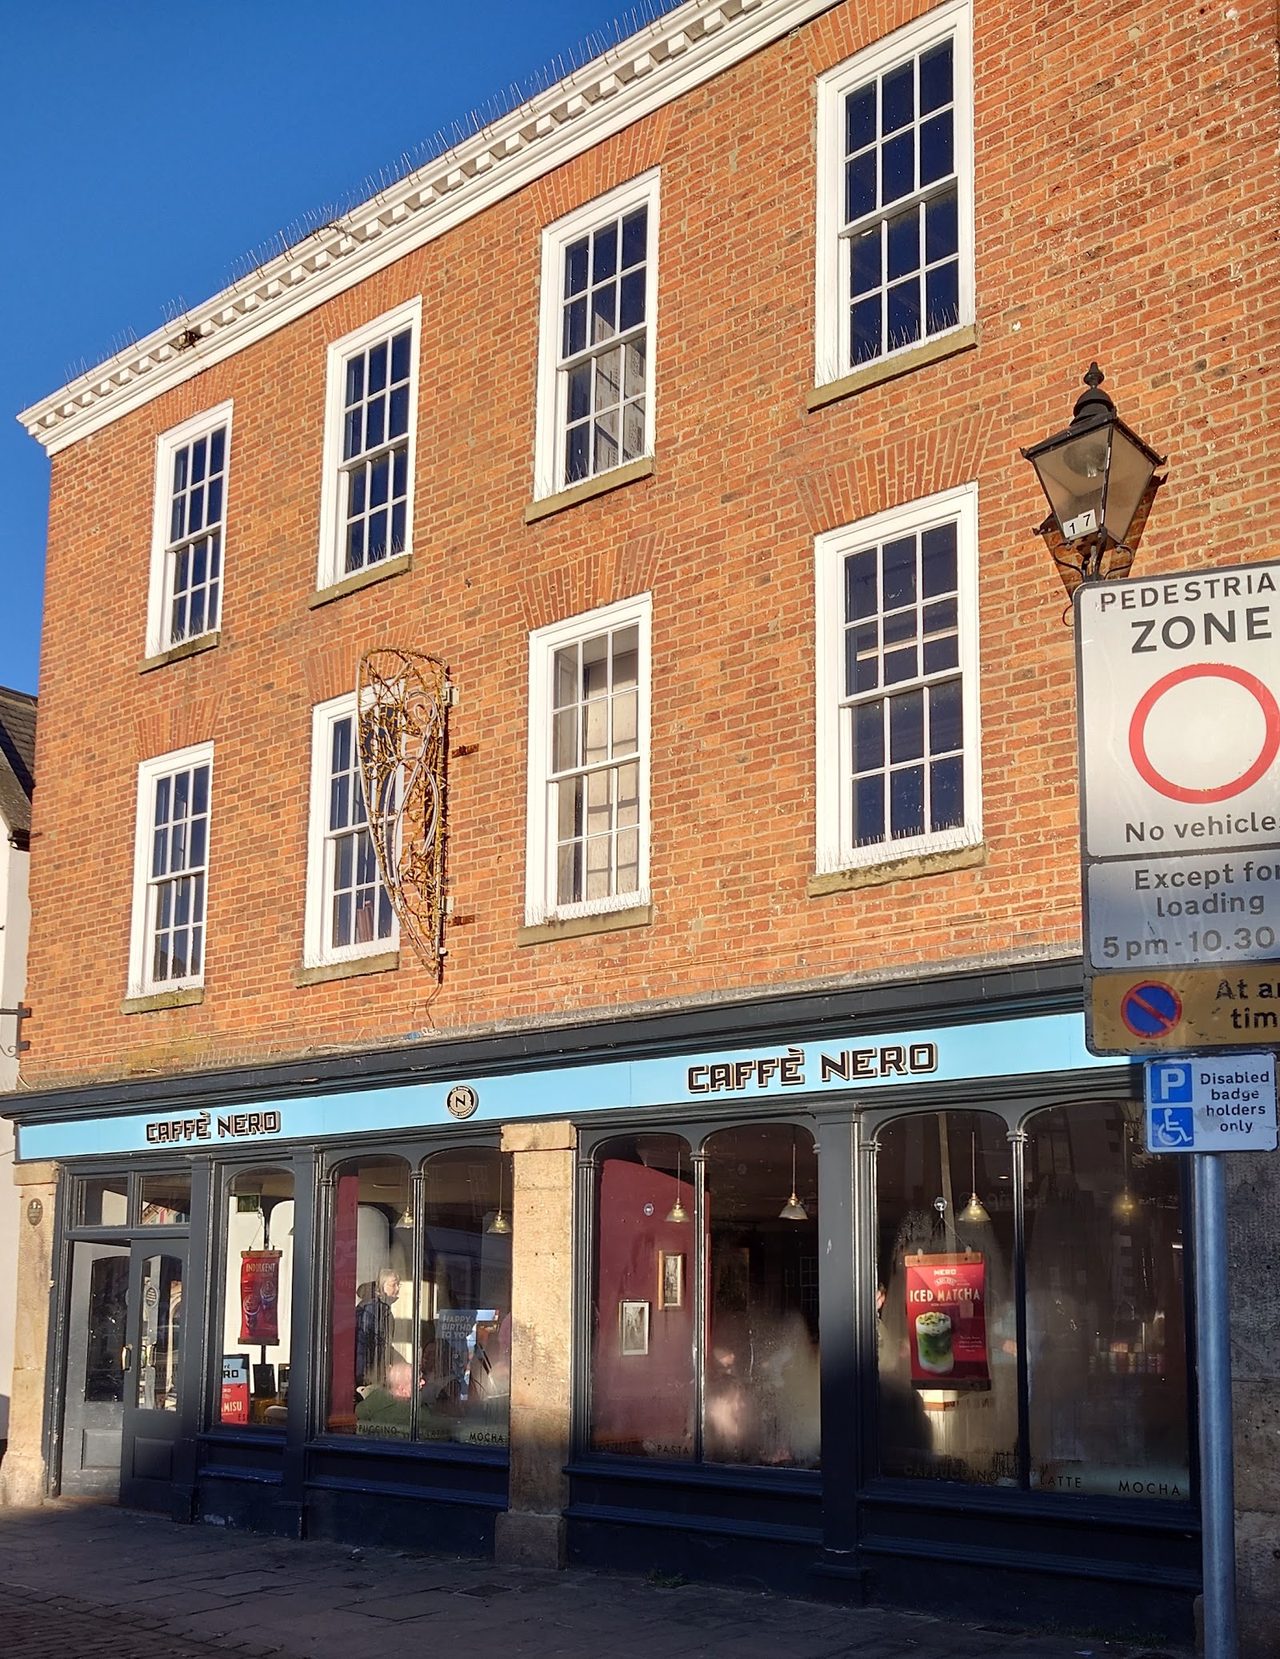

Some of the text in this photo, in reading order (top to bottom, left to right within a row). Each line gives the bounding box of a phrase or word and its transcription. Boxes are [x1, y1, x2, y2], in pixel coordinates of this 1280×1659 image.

[1100, 572, 1276, 612] PEDESTRIA
[1131, 606, 1272, 654] ZONE
[1125, 812, 1280, 843] No vehicle
[1134, 863, 1234, 889] Except
[1157, 892, 1264, 918] loading
[1215, 979, 1280, 1000] At a
[1230, 1007, 1278, 1029] tim
[686, 1042, 938, 1094] CAFFÈ NERO
[1200, 1071, 1270, 1085] Disabled
[1160, 1068, 1186, 1099] P
[455, 1094, 466, 1108] N
[1210, 1088, 1260, 1101] badge
[1206, 1104, 1266, 1116] holders
[146, 1110, 281, 1144] CAFFÈ NERO
[1220, 1120, 1253, 1133] only
[909, 1287, 981, 1303] ICED MATCHA
[442, 1314, 471, 1323] HAPPY
[441, 1331, 451, 1339] TO
[469, 1432, 504, 1443] MOCHA
[657, 1444, 690, 1454] PASTA
[1040, 1475, 1182, 1496] LATTE MOCHA
